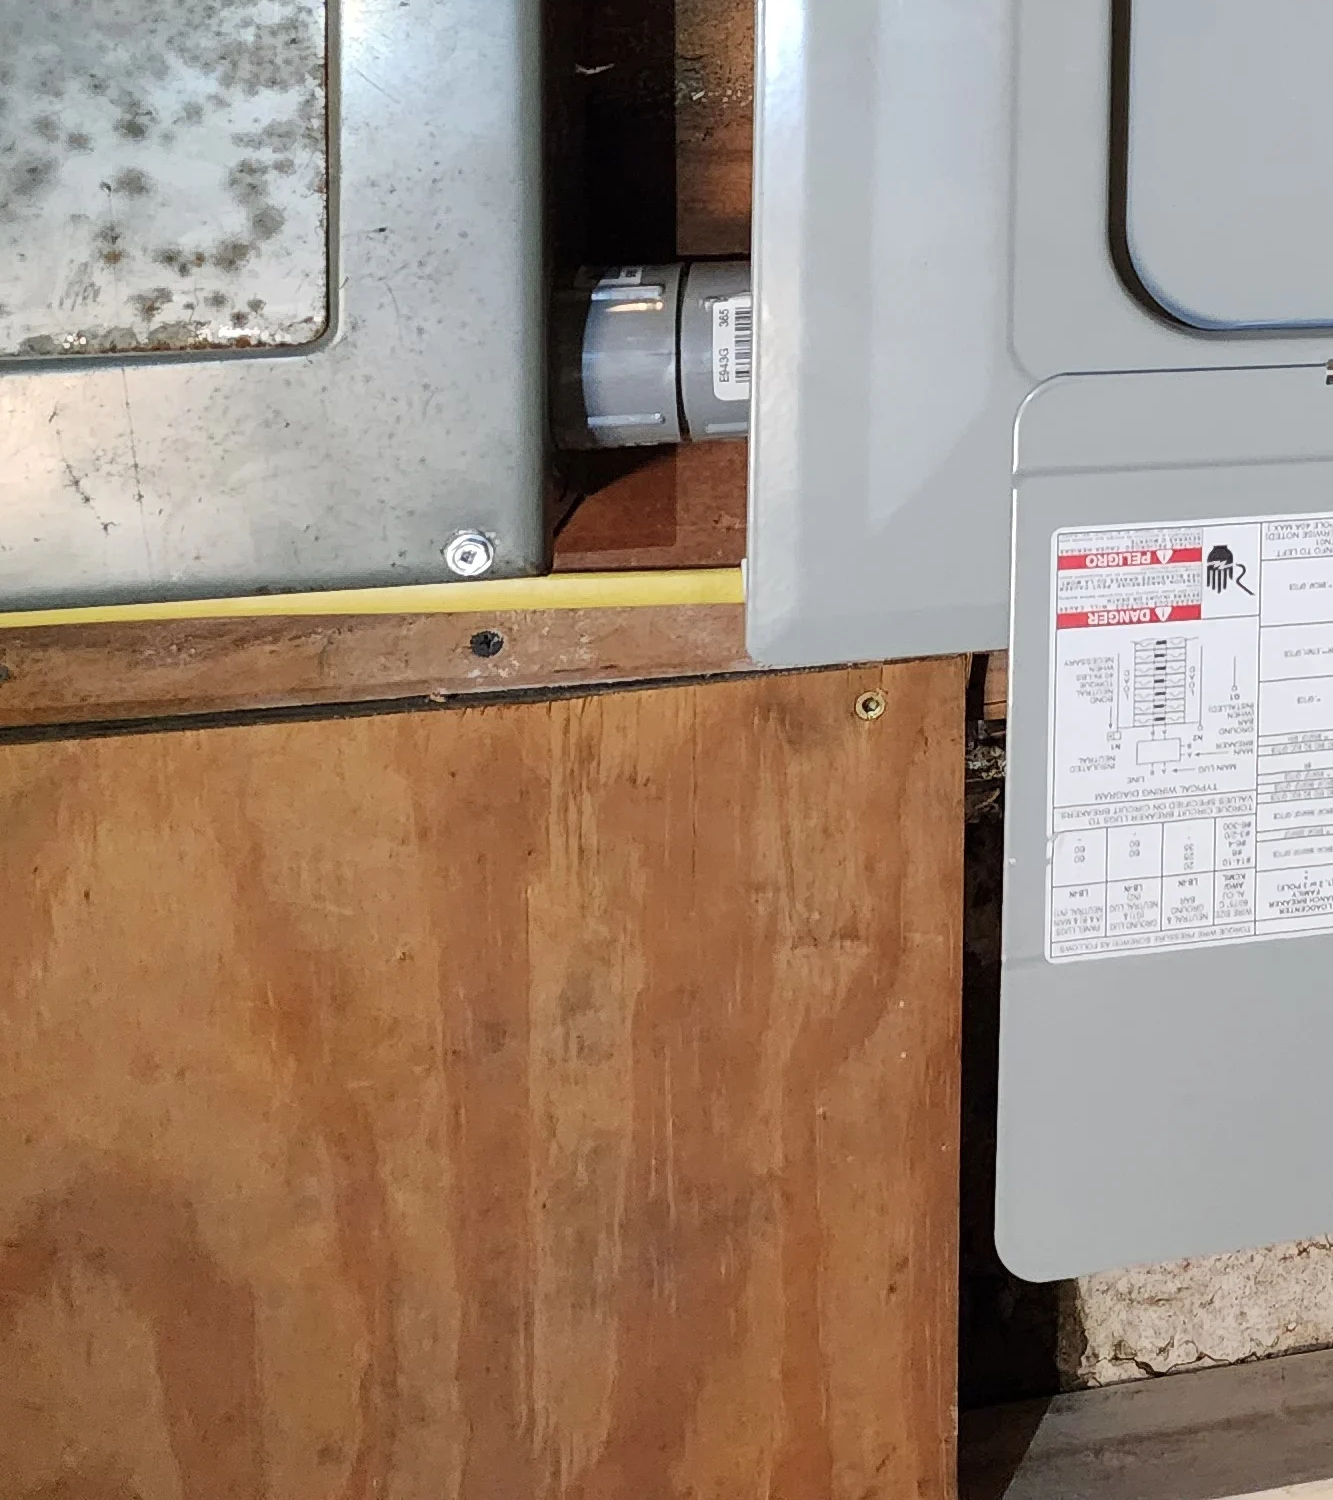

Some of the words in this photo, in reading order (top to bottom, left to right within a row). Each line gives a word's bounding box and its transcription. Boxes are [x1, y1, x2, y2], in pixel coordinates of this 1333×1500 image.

[718, 308, 730, 328] 365
[718, 347, 730, 383] E943G
[1085, 551, 1150, 566] PELIGRO
[1087, 608, 1149, 624] DANGER
[1141, 785, 1176, 796] WIRING
[1180, 782, 1217, 793] TYPICAL
[1094, 789, 1138, 801] DIAGRAM
[1176, 806, 1210, 817] CIRCUIT
[1213, 803, 1252, 813] TORQUE
[1102, 814, 1127, 824] LUGS
[1131, 810, 1173, 821] BREAKER
